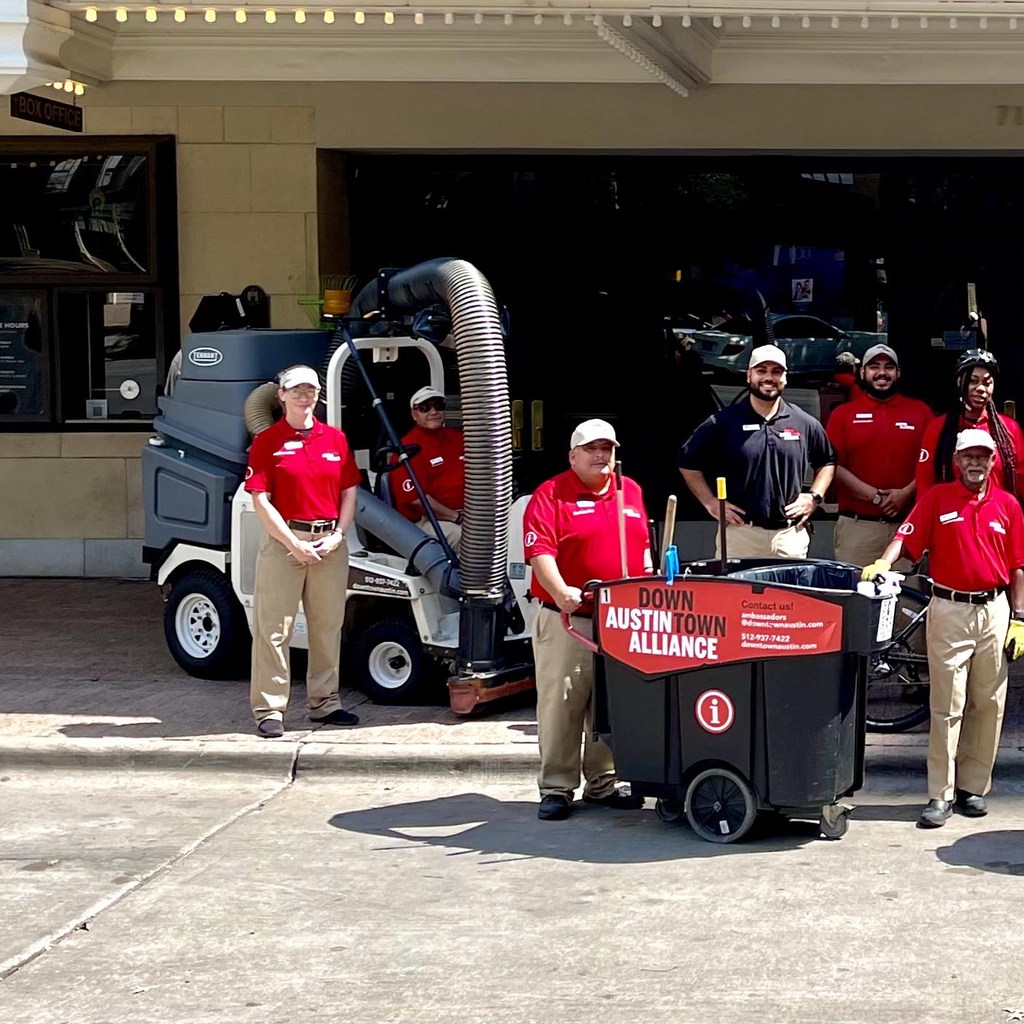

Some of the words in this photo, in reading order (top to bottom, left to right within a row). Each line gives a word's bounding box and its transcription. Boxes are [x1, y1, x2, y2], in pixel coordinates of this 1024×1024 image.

[19, 96, 42, 118] BOX
[44, 104, 81, 125] OFFICE
[603, 589, 609, 602] 1
[638, 587, 694, 611] DOWN
[741, 600, 777, 610] Contact
[779, 602, 794, 611] us!
[605, 606, 672, 633] AUSTIN
[674, 613, 727, 637] TOWN
[741, 612, 787, 621] ambassadors
[741, 633, 791, 643] 512-937-7422
[628, 632, 719, 659] ALLIANCE
[741, 641, 818, 650] downtownaustin.com
